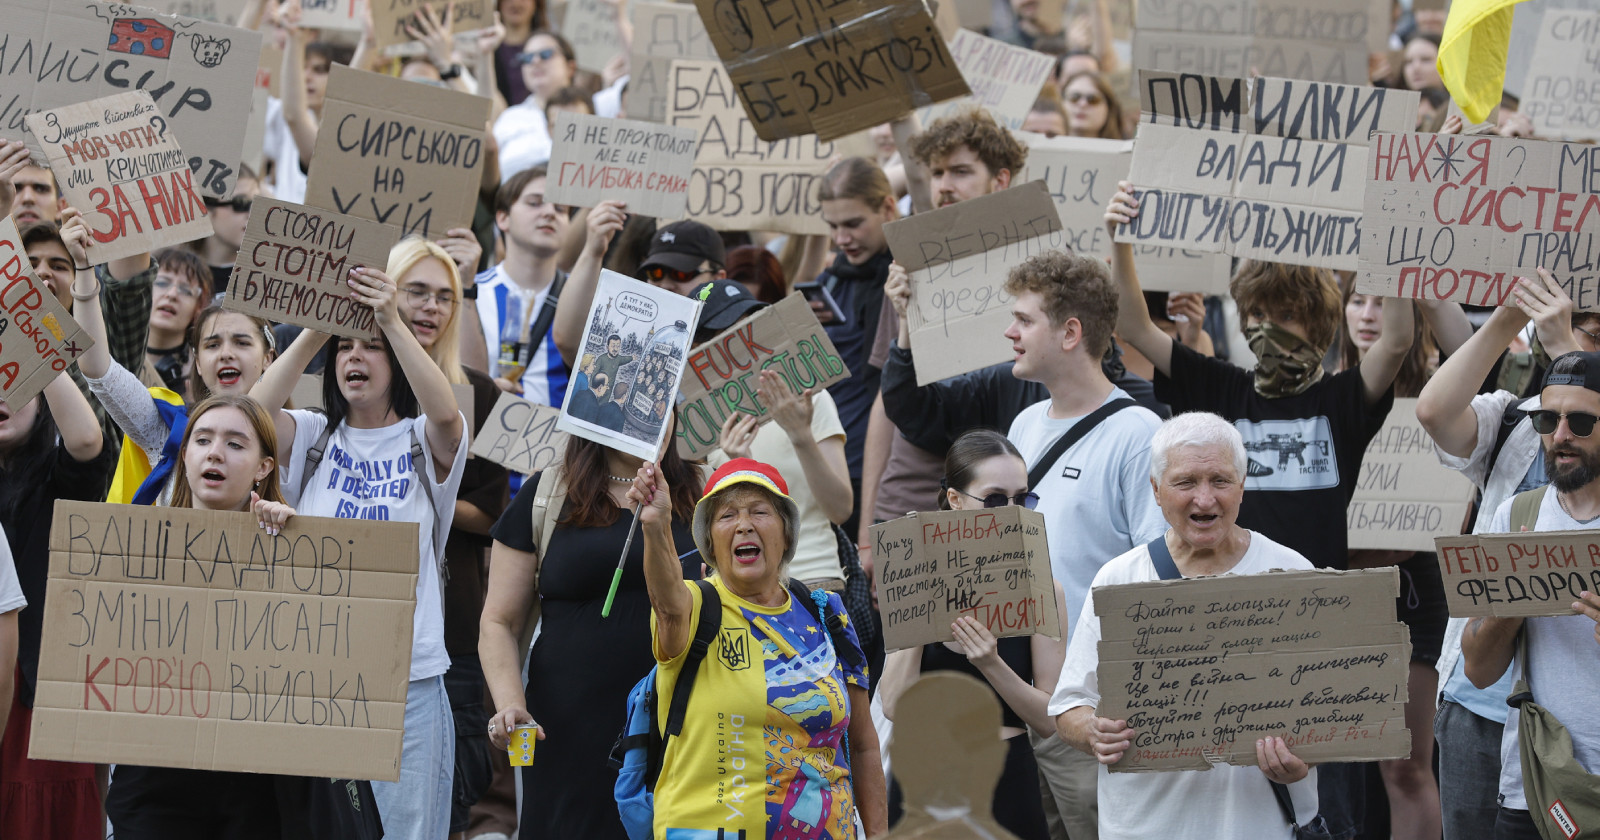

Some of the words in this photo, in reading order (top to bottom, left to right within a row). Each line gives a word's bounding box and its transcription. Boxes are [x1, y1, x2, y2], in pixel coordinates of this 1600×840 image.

[674, 66, 739, 111] БА
[1148, 73, 1386, 141] ПОМИЛКИ
[337, 114, 481, 169] СИРСЬКОГО
[563, 123, 577, 142] Я
[584, 126, 608, 145] НЕ
[627, 150, 648, 165] ЦЕ
[1197, 136, 1347, 192] ВЛАДИ
[373, 166, 405, 194] НА
[558, 161, 643, 189] ГЛИБОКА
[646, 171, 689, 193] СРАКА
[89, 184, 143, 243] ЗА
[137, 168, 208, 230] НИХ
[264, 206, 356, 254] СТОЯЛИ
[1386, 226, 1454, 266] ЩО
[243, 270, 317, 318] БУДЕМО
[688, 322, 774, 391] FUCK
[675, 371, 767, 453] YOU'RE
[327, 467, 340, 489] A
[876, 530, 913, 560] Кричу
[1442, 545, 1500, 575] ГЕТЬ
[1507, 543, 1578, 573] РУКИ
[883, 559, 937, 584] волання
[947, 550, 970, 570] НЕ
[975, 550, 1026, 576] долітає
[886, 577, 947, 603] престолу,
[954, 568, 995, 596] була
[888, 599, 936, 628] тепер
[946, 587, 983, 612] НАС
[1125, 598, 1196, 622] Дайте
[1204, 598, 1291, 615] хлопцям
[1133, 634, 1216, 664] Сирський
[1221, 637, 1264, 654] кладе
[1272, 630, 1321, 644] націю
[1137, 622, 1183, 646] дрони
[1125, 681, 1149, 699] Це
[1159, 680, 1180, 692] не
[1190, 668, 1257, 687] війна
[1290, 652, 1389, 686] знищення
[230, 662, 371, 728] ВІЙСЬКА
[1126, 709, 1202, 736] Почуйте
[1214, 699, 1294, 725] родини
[1135, 729, 1195, 748] Сестра
[1211, 721, 1287, 746] дружина
[1292, 708, 1364, 735] загиблих
[725, 713, 749, 821] Україна
[716, 781, 725, 804] 2022
[1552, 805, 1574, 835] HUNTER
